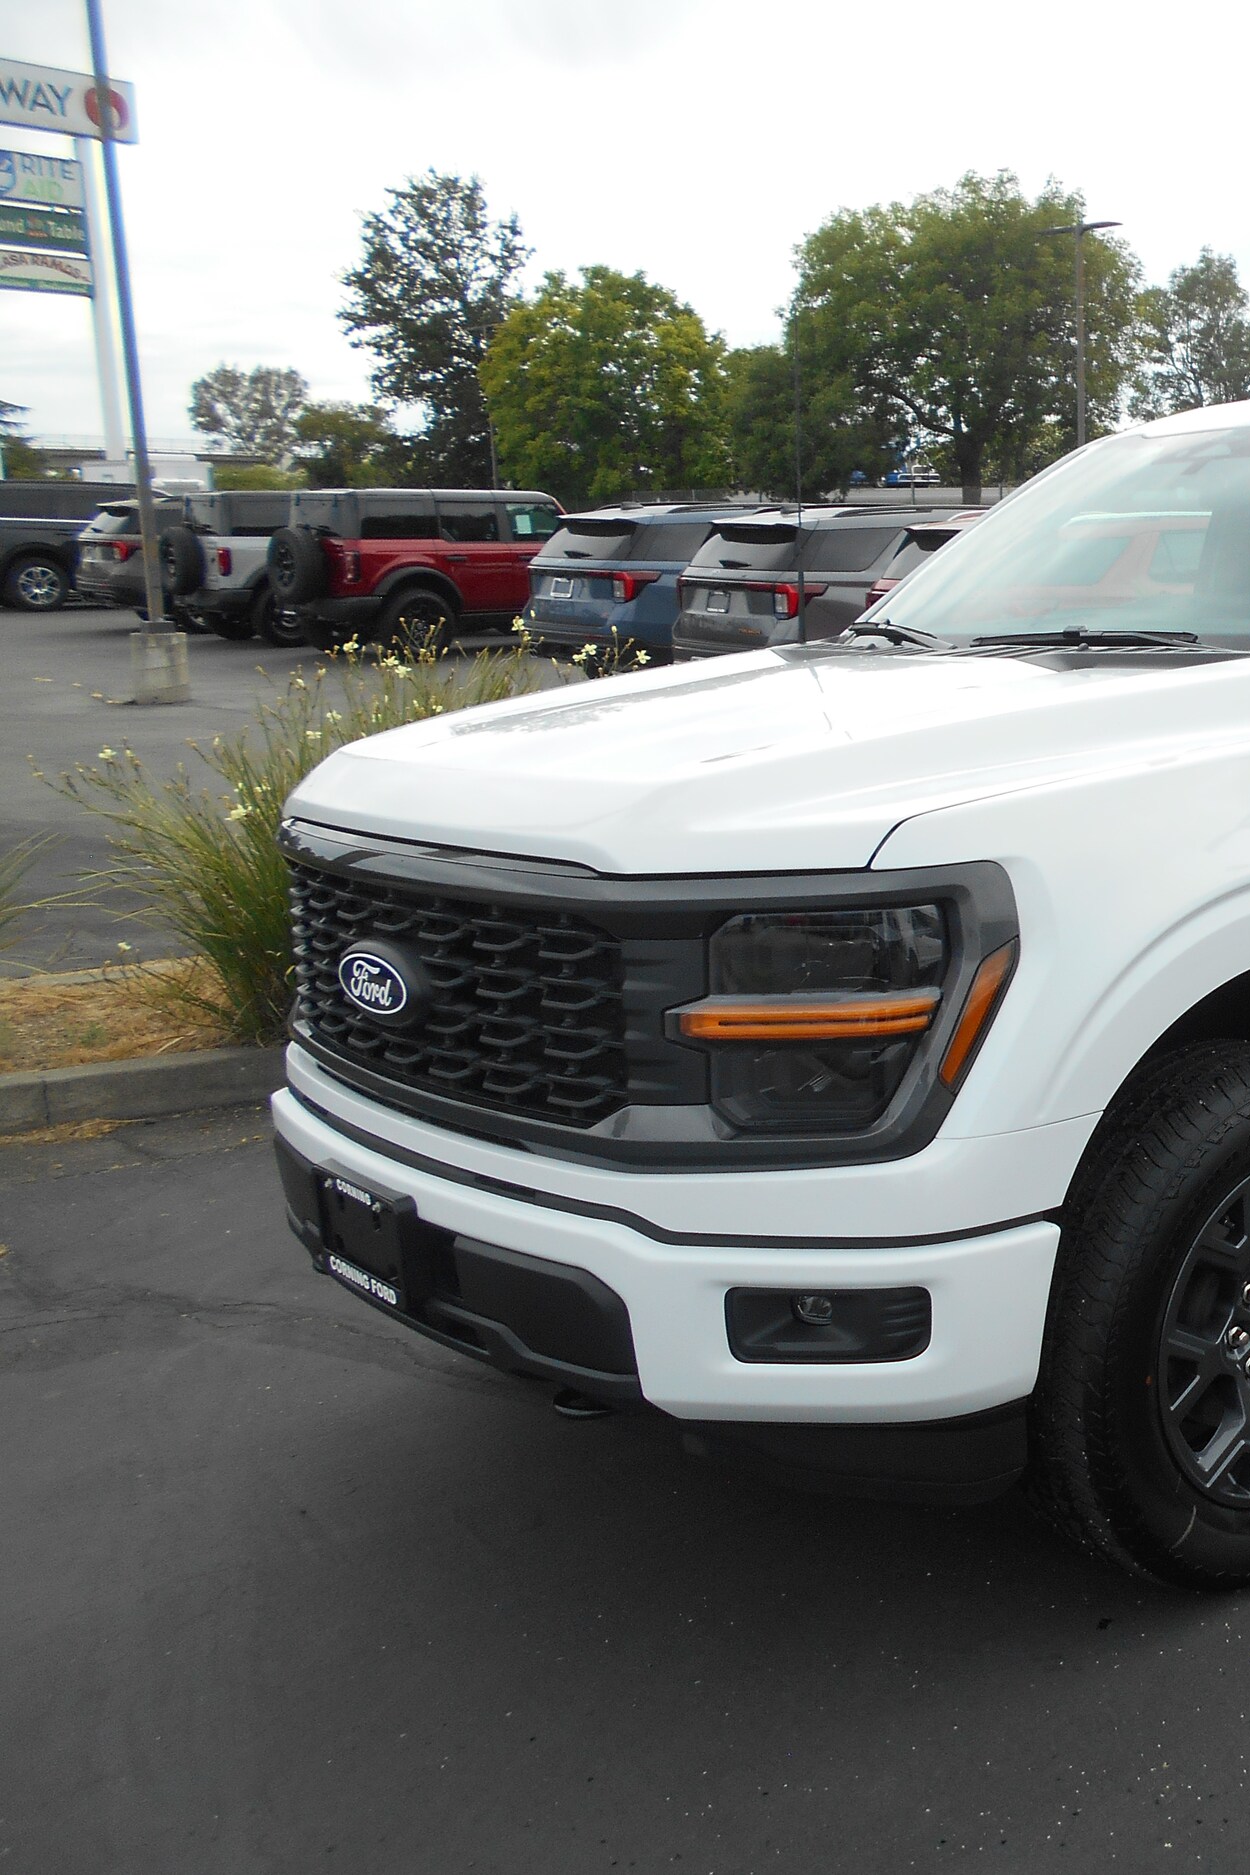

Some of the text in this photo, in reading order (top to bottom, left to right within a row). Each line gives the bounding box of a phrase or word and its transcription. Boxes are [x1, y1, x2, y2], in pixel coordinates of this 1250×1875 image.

[22, 154, 75, 180] RITE
[22, 178, 63, 200] AID
[46, 220, 85, 241] Table
[350, 960, 393, 1007] Ford
[336, 1178, 372, 1206] CORNING
[329, 1255, 397, 1305] CORNING FORD
